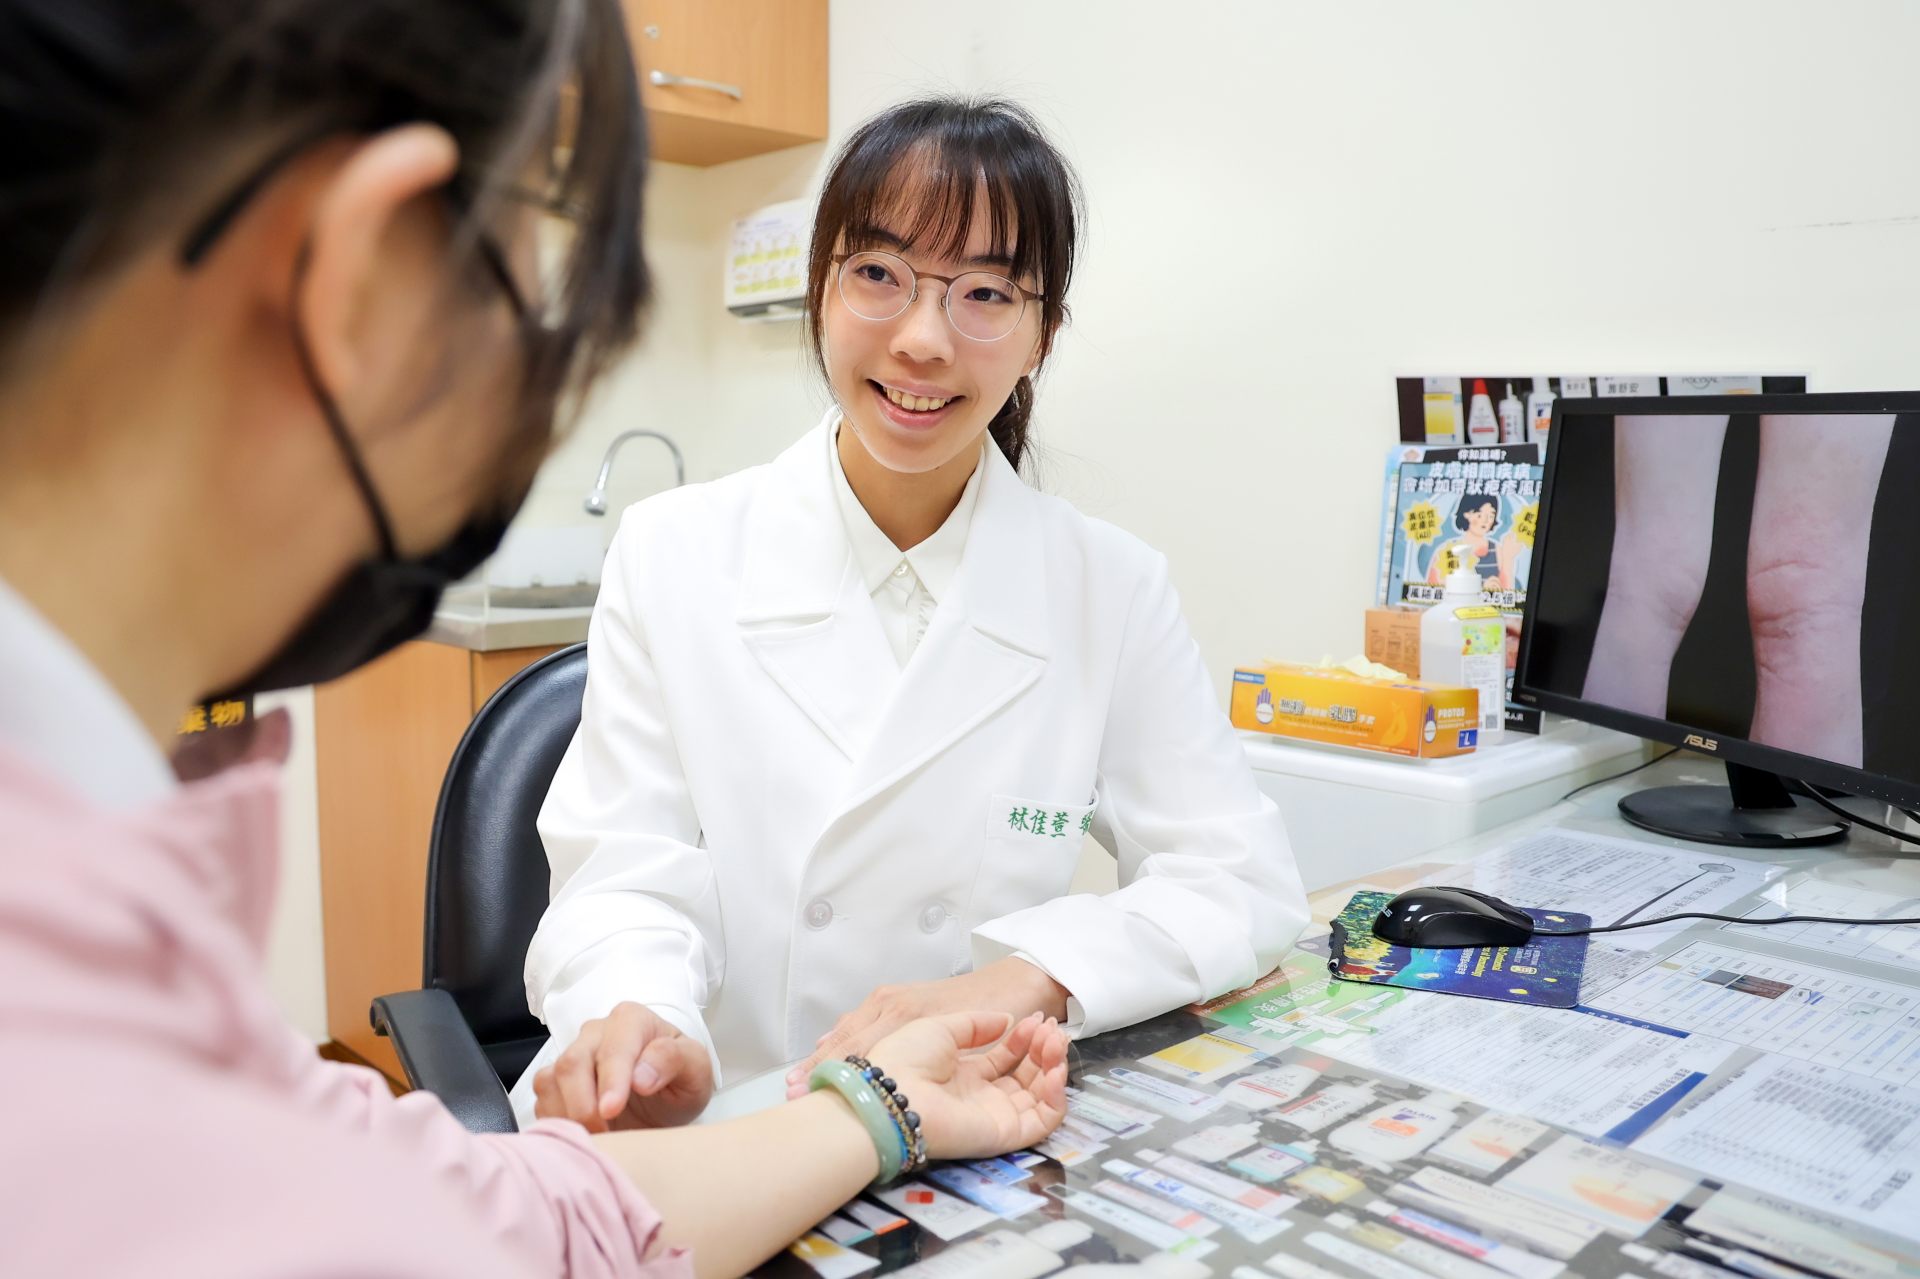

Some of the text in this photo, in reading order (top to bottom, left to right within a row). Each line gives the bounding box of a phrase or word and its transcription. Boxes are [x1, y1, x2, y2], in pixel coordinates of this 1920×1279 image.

[1458, 449, 1507, 460] 你知道嗎?
[1429, 461, 1531, 480] 皮膚相關疾病
[1463, 732, 1471, 746] L
[1683, 734, 1718, 751] ASUS
[1008, 806, 1069, 838] 林佳萱
